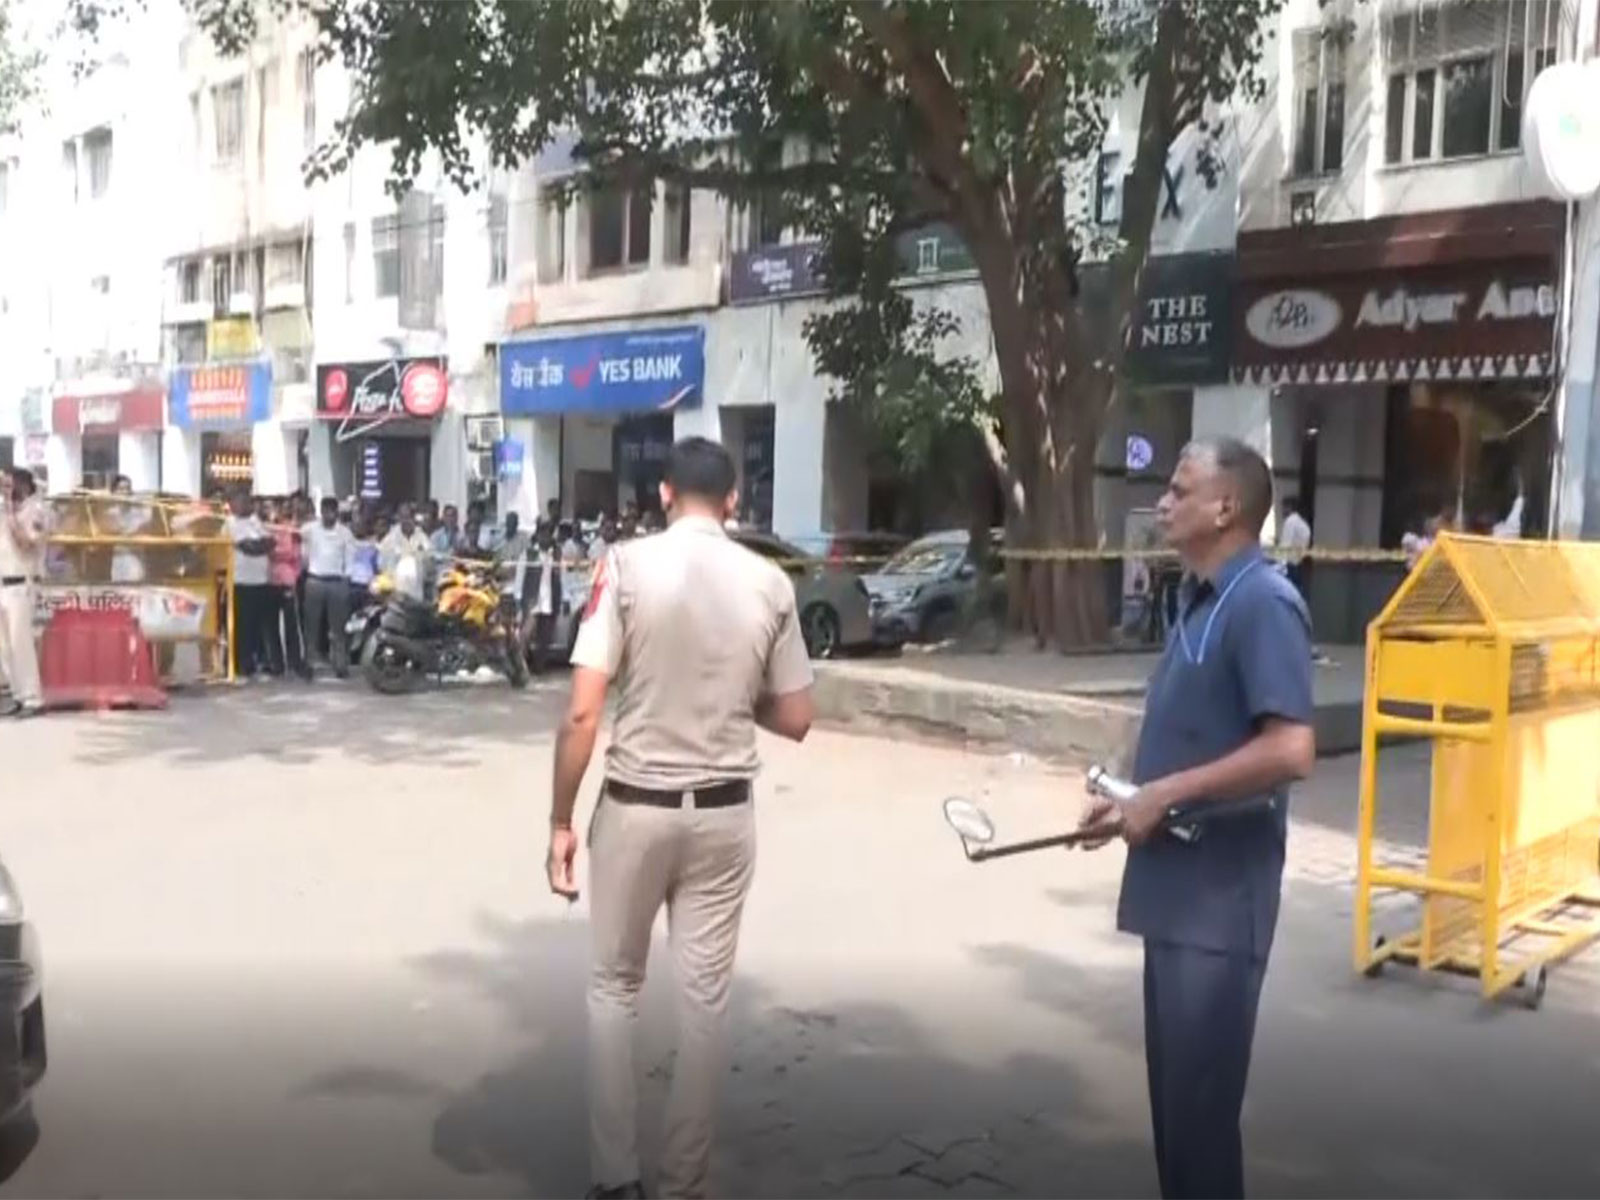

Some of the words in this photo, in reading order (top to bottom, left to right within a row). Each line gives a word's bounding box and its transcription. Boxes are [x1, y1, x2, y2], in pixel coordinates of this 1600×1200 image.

[1149, 295, 1207, 319] THE
[1141, 322, 1212, 347] NEST
[600, 357, 630, 384] YES
[633, 353, 682, 381] BANK
